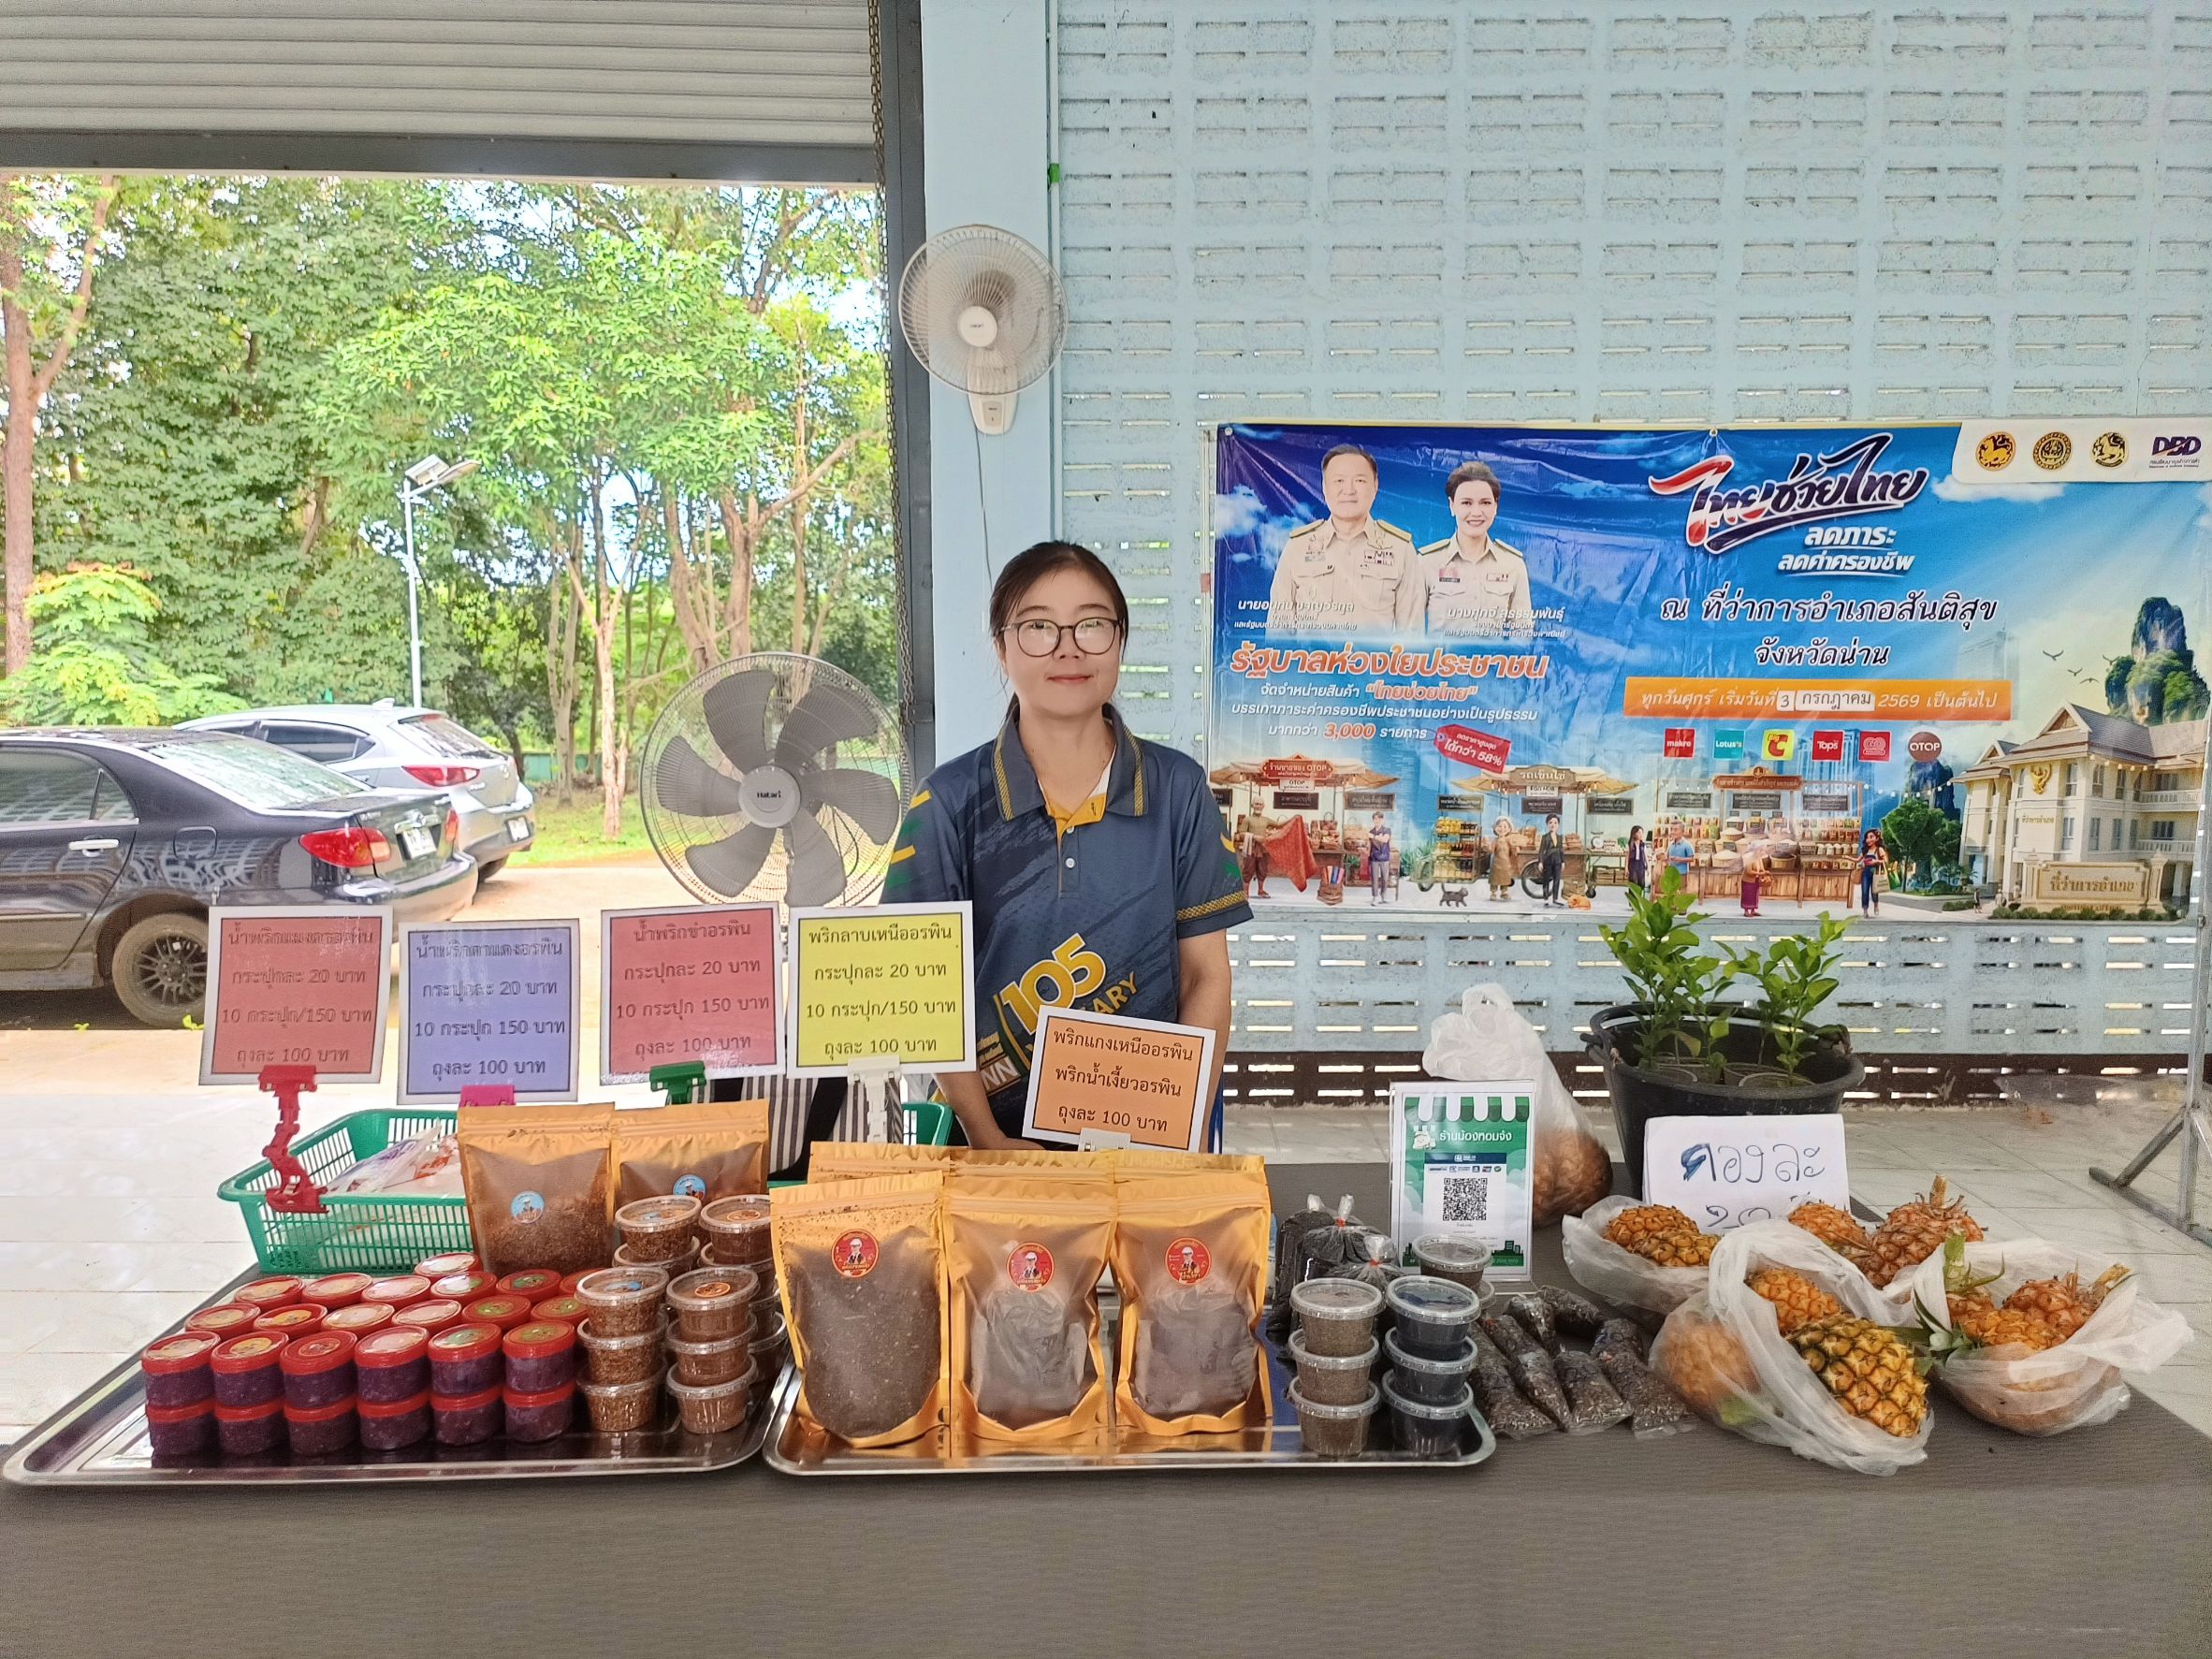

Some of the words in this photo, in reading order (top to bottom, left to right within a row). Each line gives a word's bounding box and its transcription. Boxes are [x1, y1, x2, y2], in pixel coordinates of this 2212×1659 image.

[2152, 436, 2202, 456] DBD
[1649, 432, 1930, 548] ไทยช่วยไทย
[1804, 524, 1897, 546] ลดภาระ
[1778, 550, 1915, 572] ลดค่าครองชีพ
[1660, 597, 1690, 621] ณ
[1702, 581, 1999, 633] ที่ว่าการอำเภอสันติสุข
[1230, 639, 1550, 681] รัฐบาลห่วงใยประชาชน
[1754, 637, 1891, 667] จังหวัดน่าน
[1260, 681, 1360, 698] จัดจำหน่ายสินค้า
[1642, 688, 1718, 710] ทุกวันศุกร์
[1719, 686, 1779, 706] เริ่มวันที่
[1780, 694, 1790, 707] 3
[1802, 691, 1872, 710] กรกฎาคม
[1878, 694, 1920, 707] 2569
[1927, 690, 1999, 708] เป็นต้นไป
[1231, 702, 1539, 724] บรรเทาภาระค่าครองชีพประชาชนอย่างเป็นรูปธรรม
[1268, 723, 1318, 737] มากกว่า
[1323, 721, 1376, 740] 3,000
[1379, 726, 1428, 740] รายการ
[1666, 739, 1692, 748] makro
[1817, 740, 1839, 750] Tops
[1910, 742, 1942, 751] OTOP
[1306, 764, 1327, 772] OTOP
[1477, 751, 1503, 766] 58%
[633, 920, 751, 942] น้ำพริกข่าอรพิน
[809, 923, 952, 944] พริกลาบเหนืออรพิน
[233, 968, 304, 989] กระปุกละ
[308, 969, 330, 983] 20
[335, 970, 366, 983] บาท
[624, 962, 696, 983] กระปุกละ
[703, 961, 722, 975] 20
[728, 960, 761, 973] บาท
[815, 964, 883, 985] กระปุกละ
[890, 964, 910, 978] 20
[914, 964, 947, 978] บาท
[422, 982, 495, 1003] กระปุกละ
[500, 982, 521, 996] 20
[526, 982, 558, 996] บาท
[999, 933, 1107, 1036] 105
[1080, 971, 1140, 1015] ARY
[223, 1009, 240, 1024] 10
[247, 1007, 336, 1029] กระปุก/150
[342, 1009, 372, 1024] บาท
[617, 1004, 636, 1019] 10
[642, 998, 694, 1021] กระปุก
[703, 997, 732, 1013] 150
[737, 997, 770, 1011] บาท
[807, 1004, 825, 1019] 10
[831, 999, 918, 1023] กระปุก/150
[924, 1000, 956, 1014] บาท
[415, 1022, 435, 1038] 10
[441, 1019, 492, 1041] กระปุก
[499, 1021, 529, 1035] 150
[533, 1021, 565, 1034] บาท
[635, 1041, 675, 1061] ถุงละ
[683, 1037, 713, 1053] 100
[719, 1036, 751, 1050] บาท
[824, 1041, 863, 1061] ถุงละ
[870, 1039, 899, 1054] 100
[905, 1039, 937, 1052] บาท
[1054, 1027, 1193, 1061] พริกแกงเหนืออรพิน
[237, 1050, 274, 1068] ถุงละ
[283, 1048, 311, 1063] 100
[317, 1050, 349, 1063] บาท
[432, 1062, 472, 1082] ถุงละ
[478, 1060, 508, 1075] 100
[514, 1060, 546, 1074] บาท
[1055, 1063, 1182, 1097] พริกน้ำเงี้ยวอรพิน
[1058, 1105, 1096, 1124] ถุงละ
[1102, 1111, 1130, 1127] 100
[1136, 1116, 1168, 1132] บาท
[1439, 1129, 1512, 1142] ร้านน้องหอมจัง
